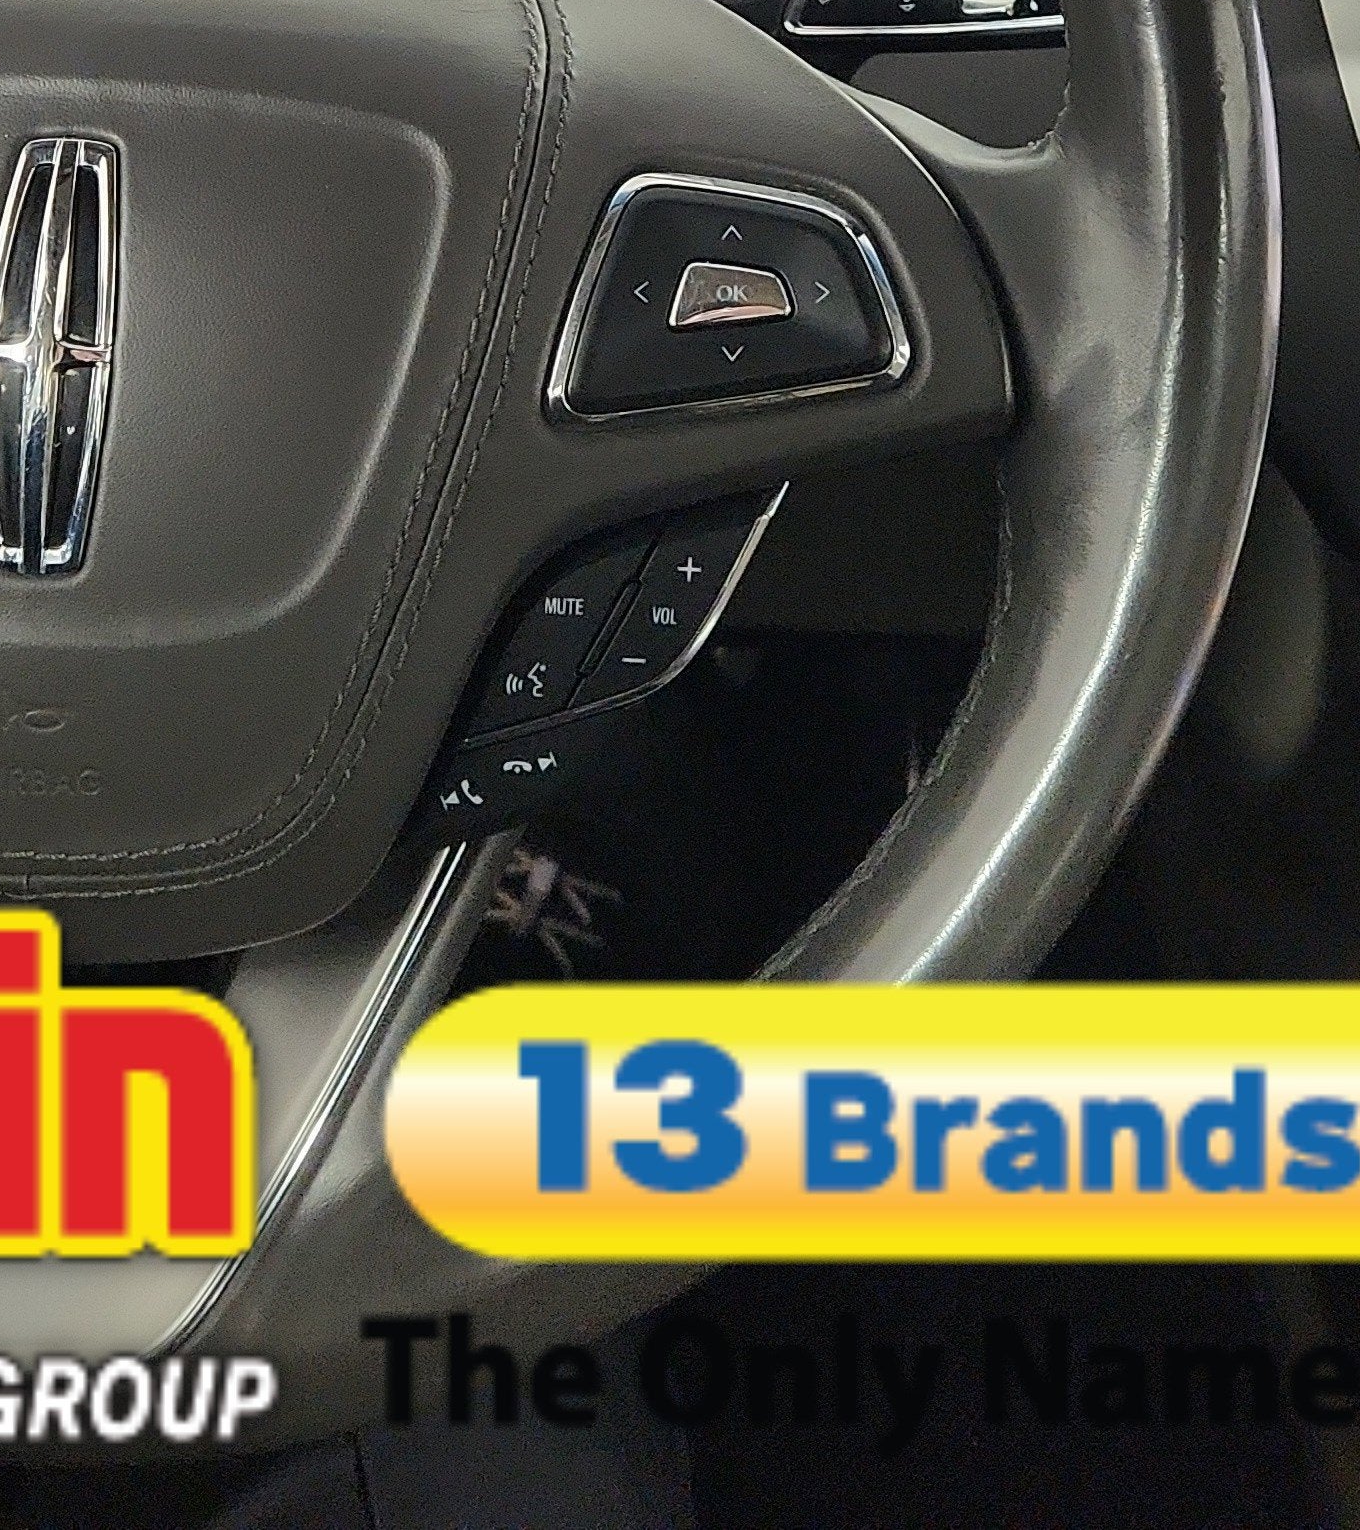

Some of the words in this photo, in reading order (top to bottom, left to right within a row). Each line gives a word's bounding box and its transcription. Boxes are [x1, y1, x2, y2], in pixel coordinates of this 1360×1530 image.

[715, 284, 749, 303] OK
[543, 596, 585, 617] MUTE
[651, 606, 678, 627] VOL
